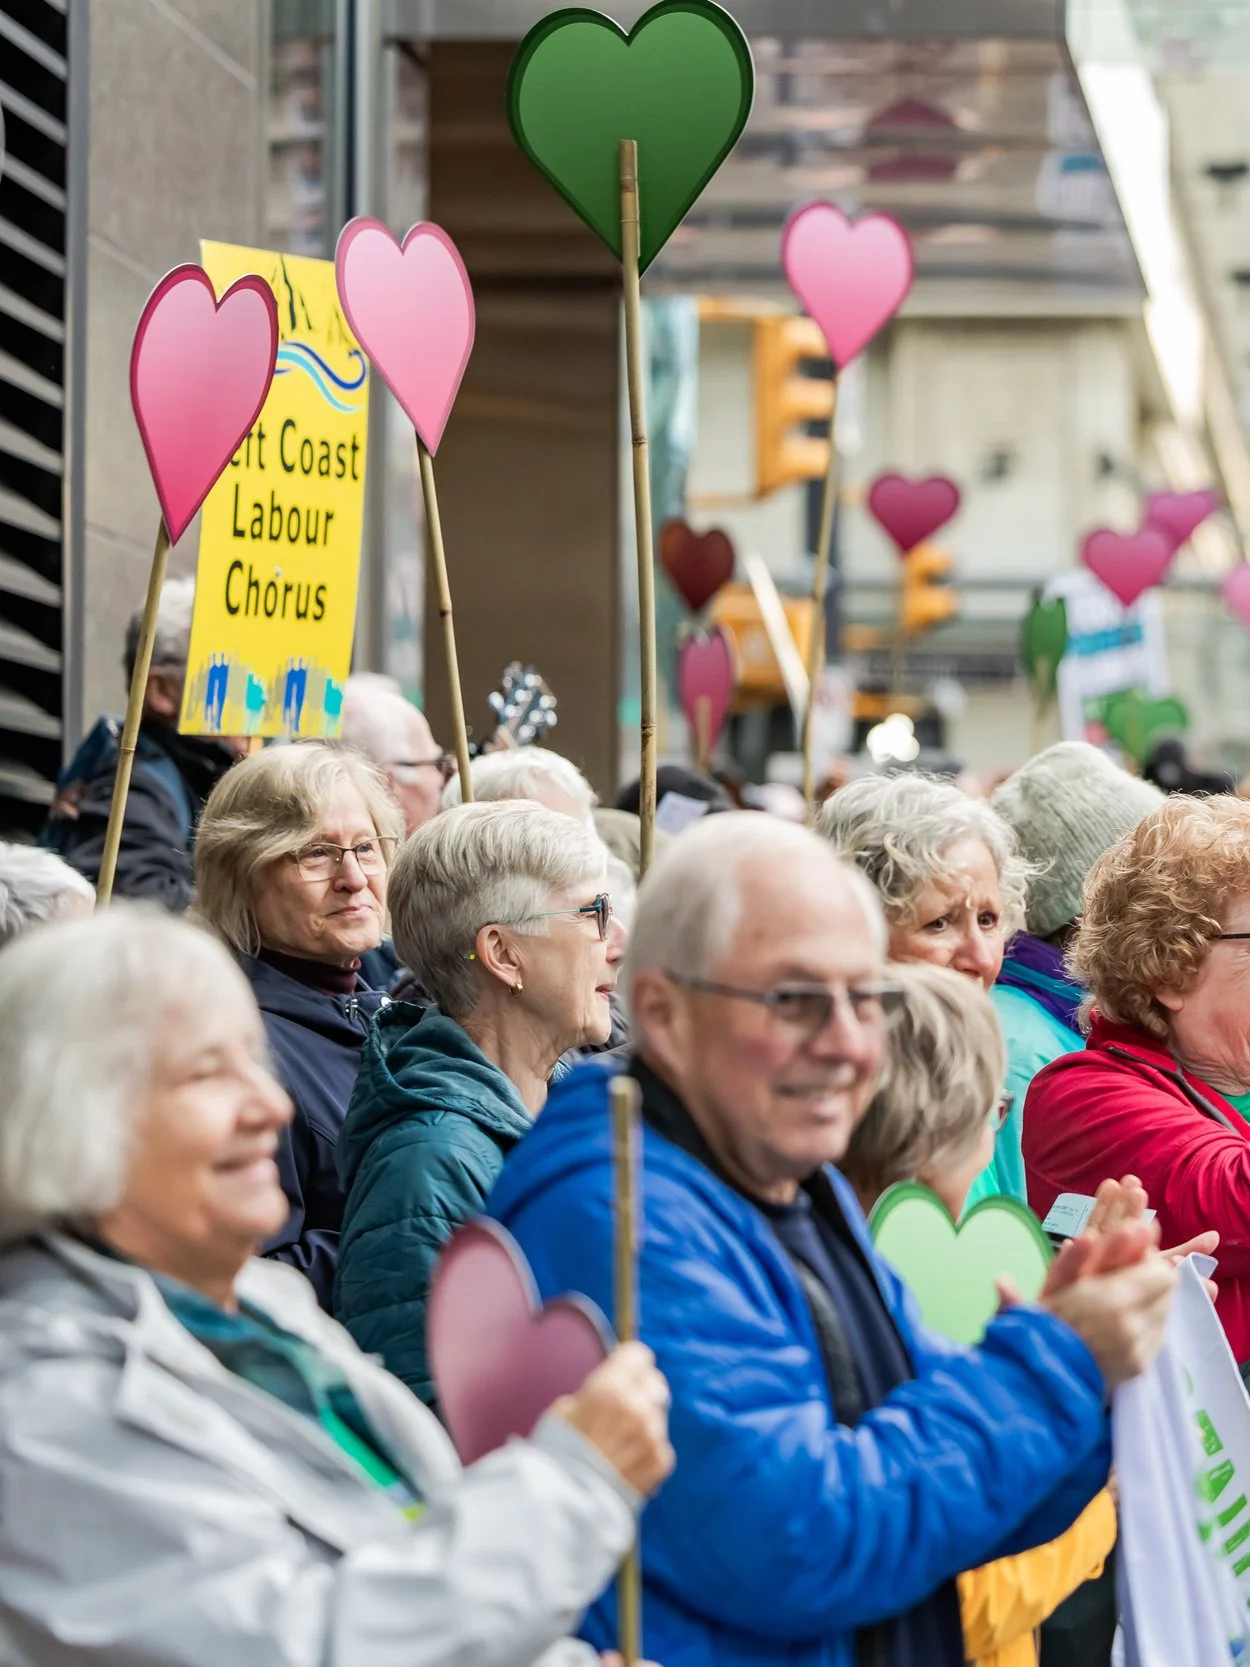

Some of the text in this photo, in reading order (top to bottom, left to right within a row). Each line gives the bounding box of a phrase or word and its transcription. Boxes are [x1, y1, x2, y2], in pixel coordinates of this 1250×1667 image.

[280, 418, 360, 481] Coast
[232, 483, 334, 546] Labour
[225, 560, 328, 621] Chorus
